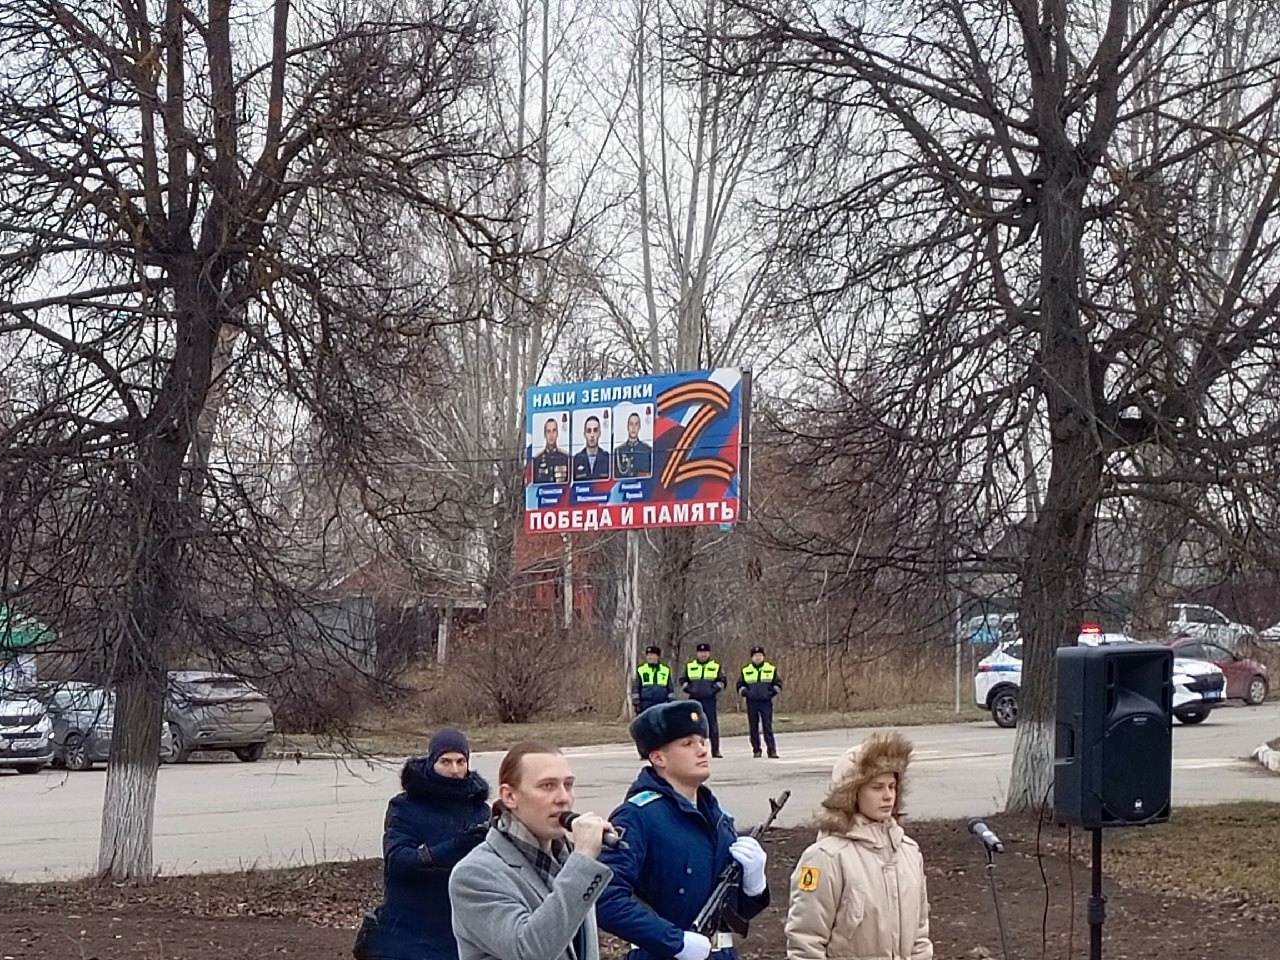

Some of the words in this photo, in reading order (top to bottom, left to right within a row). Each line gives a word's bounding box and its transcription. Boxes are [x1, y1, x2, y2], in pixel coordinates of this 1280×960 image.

[533, 390, 576, 408] НАШИ
[581, 383, 653, 404] ЗЕМЛЯКИ
[529, 508, 613, 532] ПОБЕДА
[621, 507, 634, 526] И
[642, 501, 735, 525] ПАМЯТЬ
